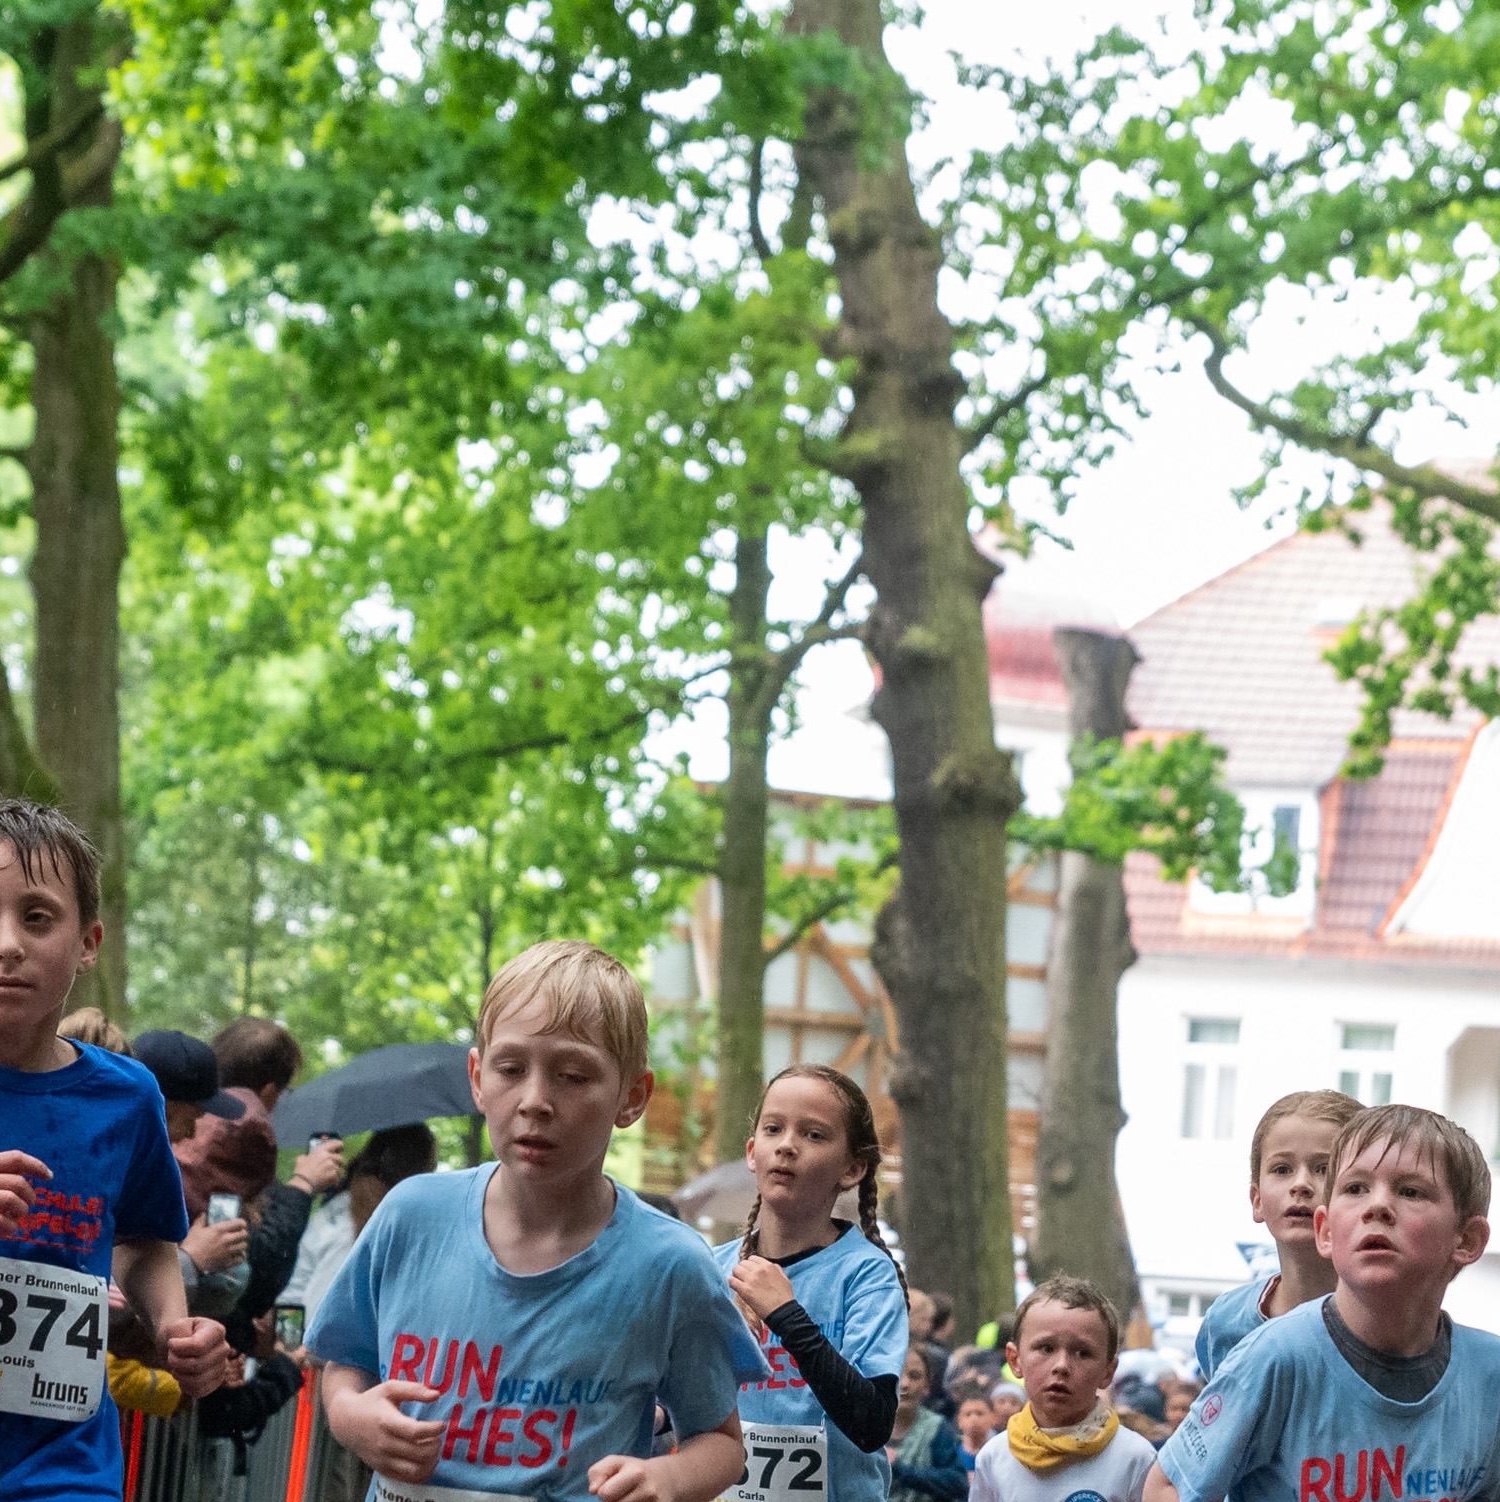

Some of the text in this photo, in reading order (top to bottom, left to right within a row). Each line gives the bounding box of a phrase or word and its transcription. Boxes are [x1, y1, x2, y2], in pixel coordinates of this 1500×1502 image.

[25, 1274, 99, 1297] Brunnenlauf
[388, 1334, 503, 1402] RUN
[31, 1373, 88, 1405] bruns
[441, 1403, 577, 1468] HES!
[750, 1433, 817, 1444] Brunnenlauf
[732, 1446, 823, 1491] 72
[738, 1490, 765, 1502] Carla
